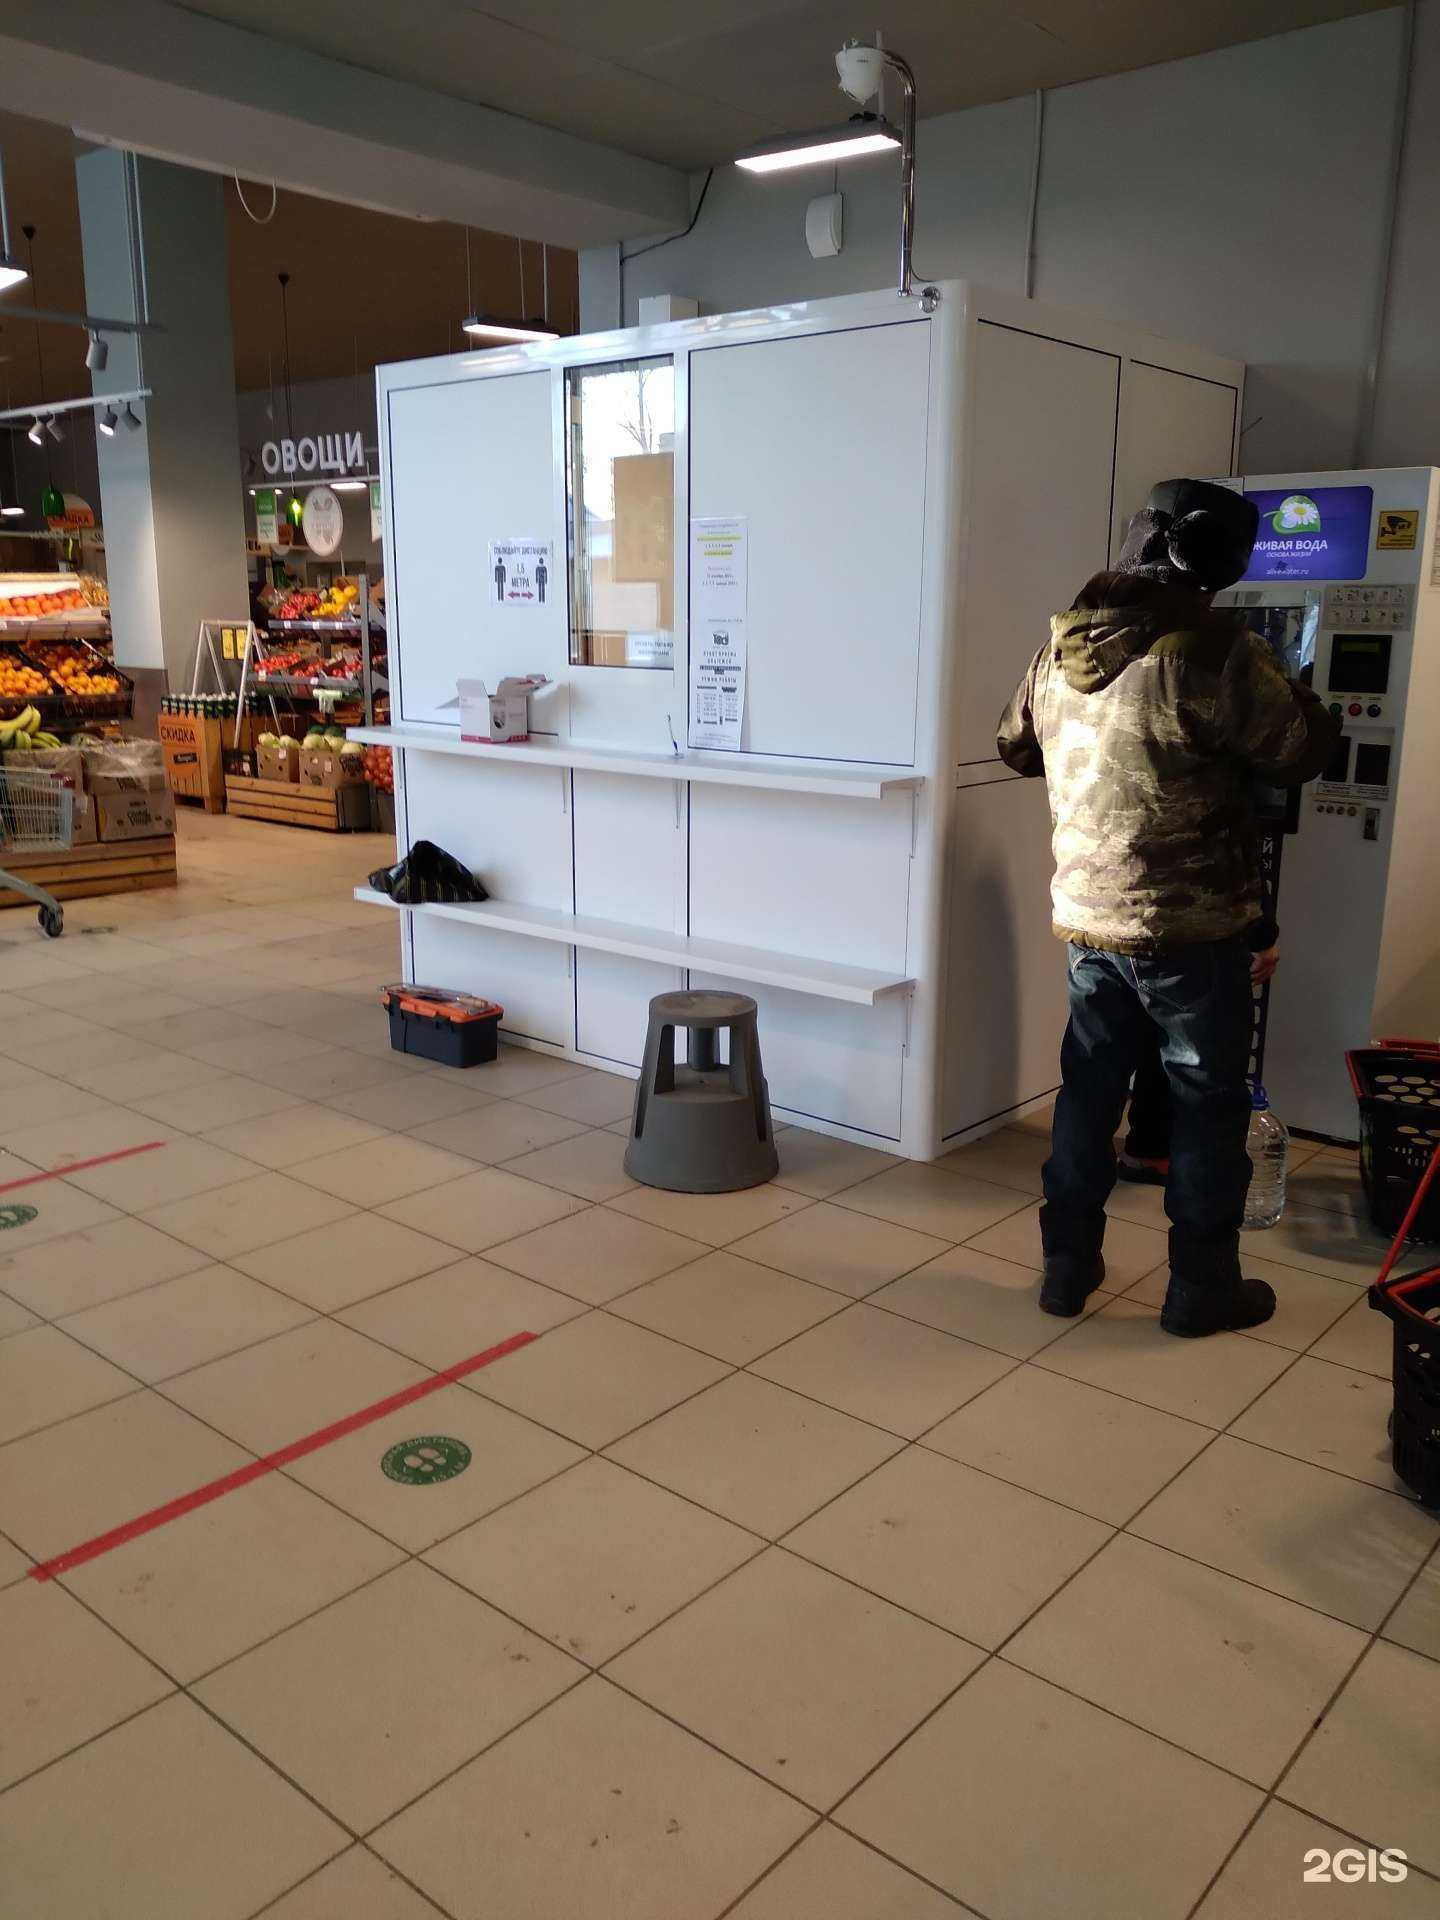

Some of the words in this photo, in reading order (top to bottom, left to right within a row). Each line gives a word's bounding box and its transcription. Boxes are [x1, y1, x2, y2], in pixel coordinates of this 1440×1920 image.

[262, 431, 364, 475] ОВОЩИ
[1253, 540, 1293, 551] ЖИВАЯ
[1295, 539, 1328, 552] ВОДА
[512, 577, 530, 588] МЕТРА
[161, 726, 196, 743] СКИДКА
